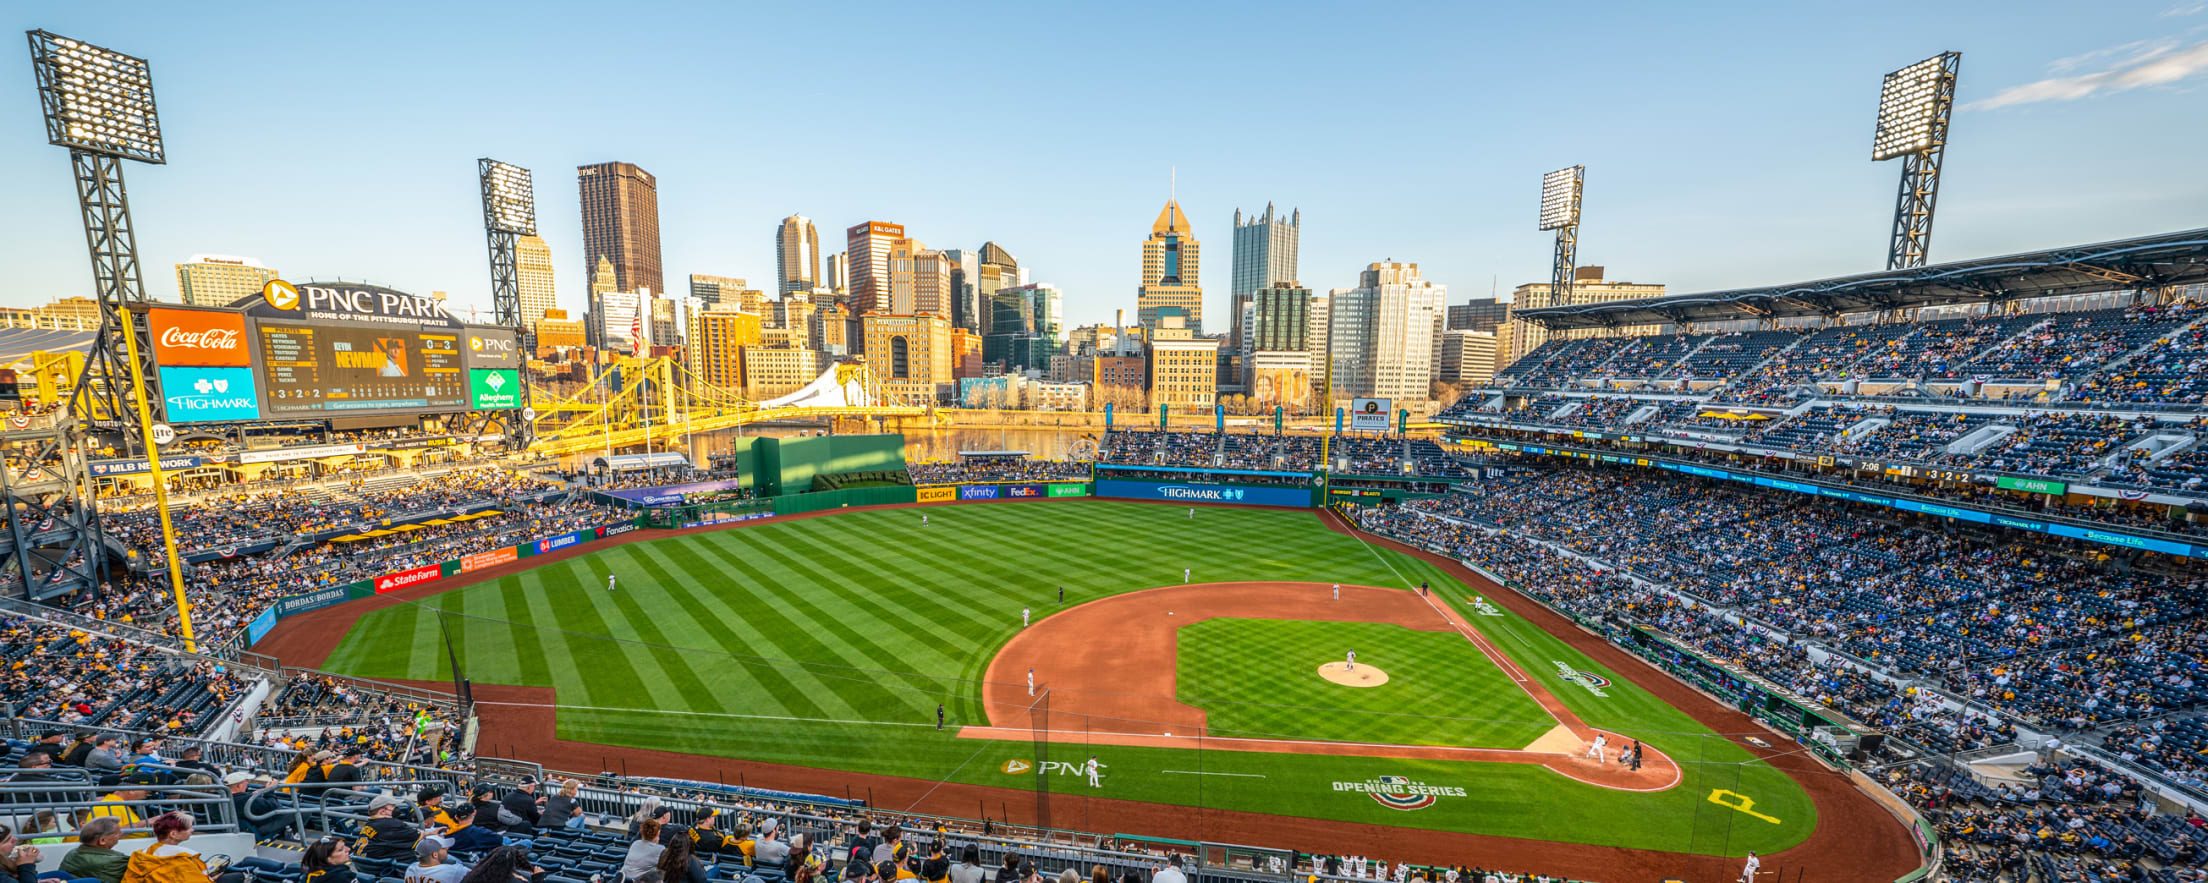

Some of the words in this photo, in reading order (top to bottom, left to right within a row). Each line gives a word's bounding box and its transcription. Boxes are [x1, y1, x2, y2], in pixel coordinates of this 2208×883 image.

[303, 286, 374, 313] PNC
[377, 292, 449, 319] PARK
[311, 311, 338, 319] HOME
[338, 312, 351, 320] OF
[352, 313, 369, 322] THE
[371, 315, 418, 325] PITTSBURGH
[419, 318, 448, 327] PIRATES
[161, 326, 239, 349] Coca-Cola
[444, 340, 451, 350] 3
[484, 338, 512, 351] PNC
[335, 351, 389, 369] NEWMAN
[278, 389, 286, 398] 3
[295, 389, 303, 398] 2
[313, 389, 320, 397] 2
[479, 393, 514, 403] Allegheny
[168, 396, 255, 409] HIGHMARK
[109, 461, 136, 473] MLB
[138, 458, 193, 471] NEWORK
[1861, 462, 1880, 471] 7:06
[1930, 469, 1938, 478] 3
[1945, 471, 1952, 480] 2
[1961, 473, 1969, 482] 2
[964, 487, 996, 498] xfinity
[1011, 487, 1036, 496] FedEx
[2025, 481, 2047, 491] AHN
[930, 490, 953, 499] LIGHT
[1158, 486, 1222, 500] HIGHMARK
[606, 524, 634, 537] Fanatics
[551, 536, 576, 548] LUMBER
[2087, 531, 2125, 544] Because
[2126, 535, 2146, 547] Life.
[285, 595, 314, 609] BORDAS
[317, 589, 344, 603] BORDAS
[1332, 781, 1403, 794] OPENING
[1407, 785, 1467, 797] SERIES
